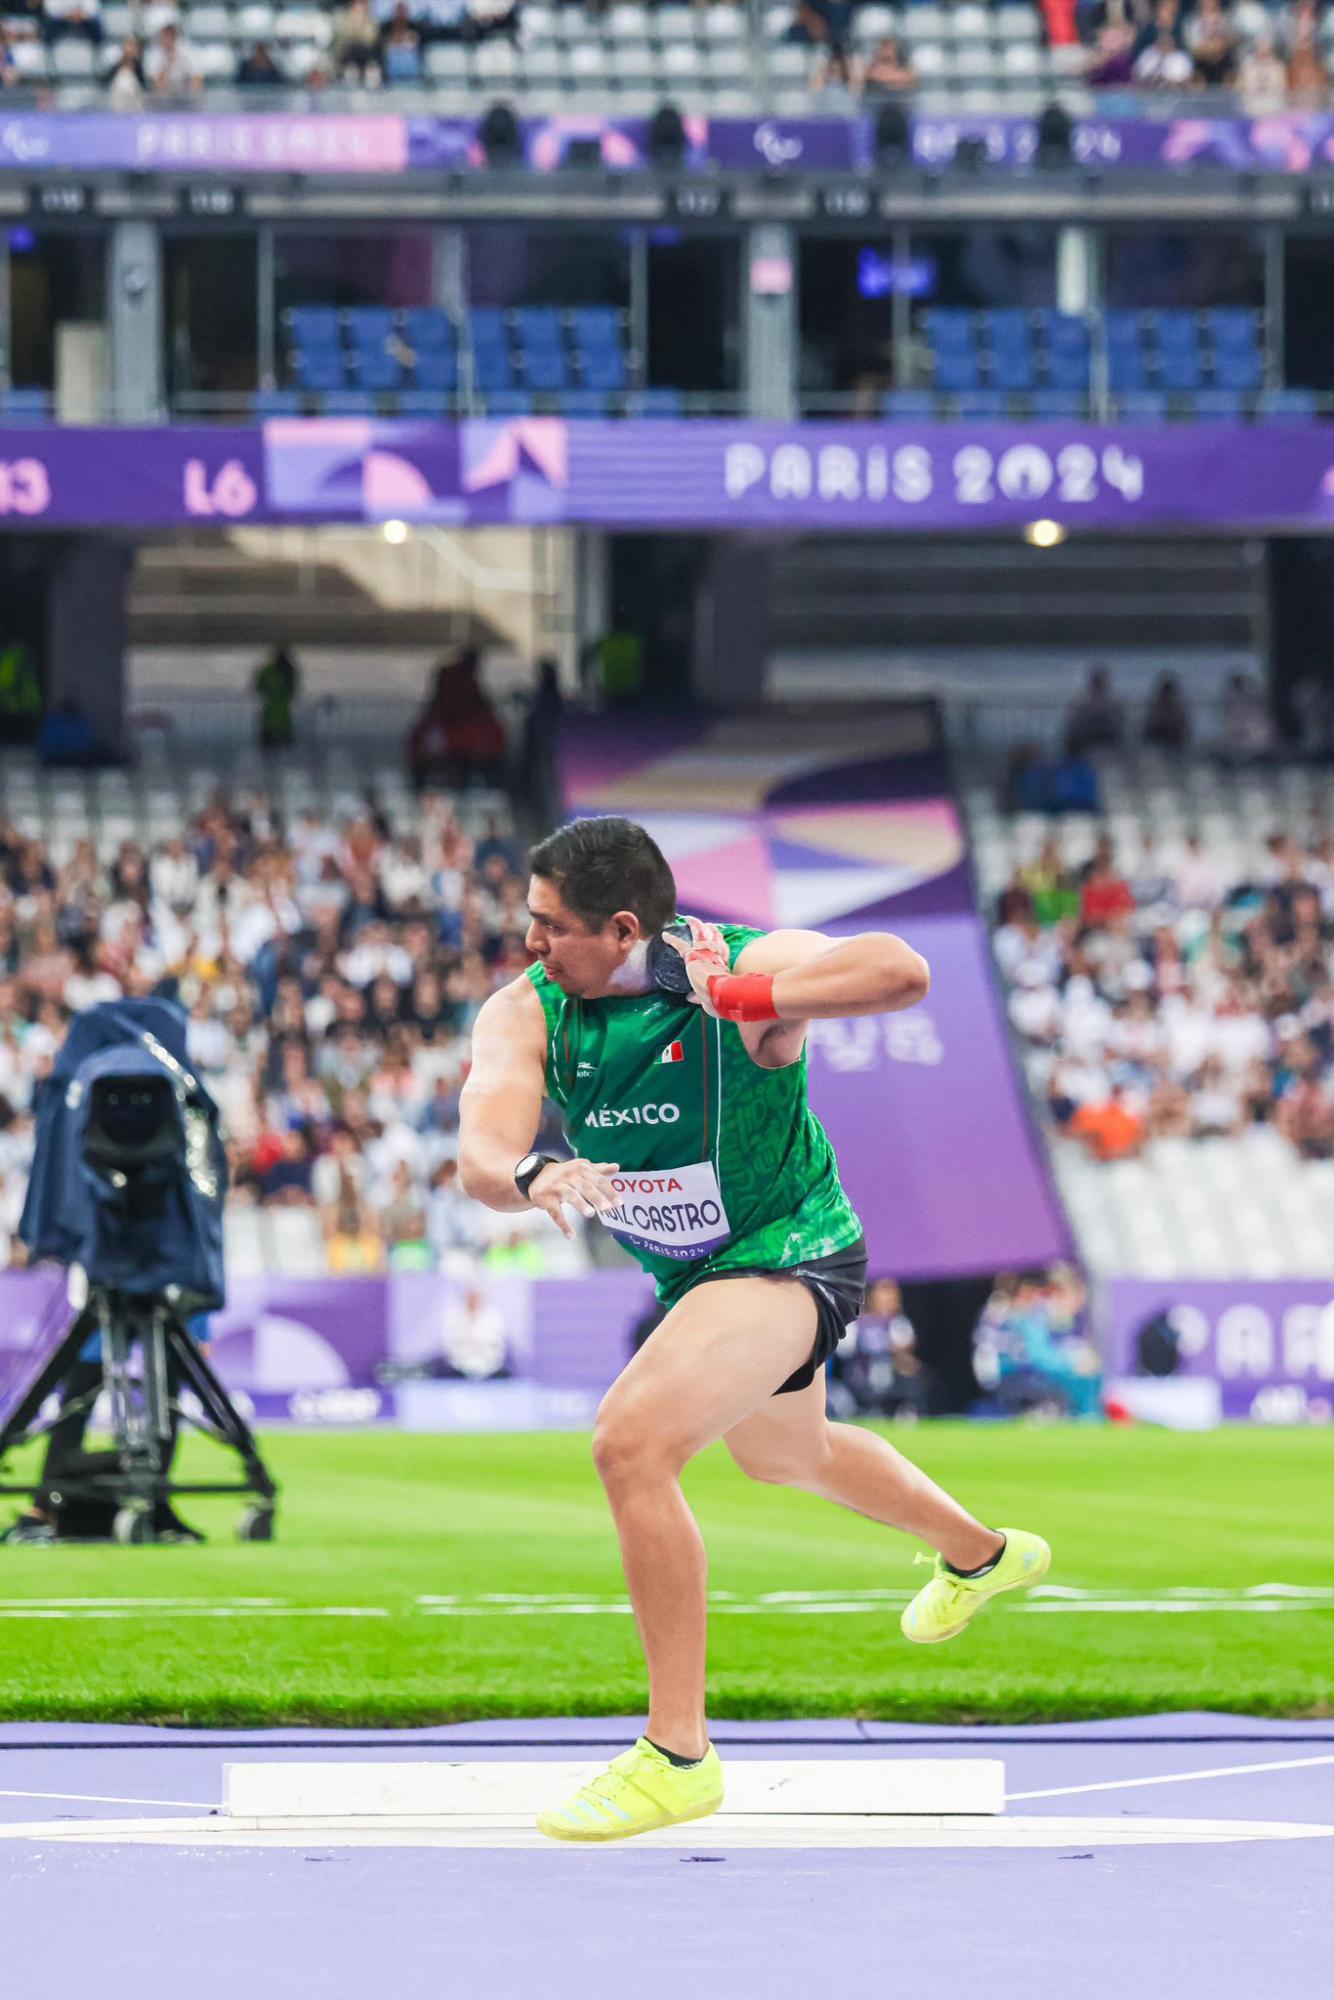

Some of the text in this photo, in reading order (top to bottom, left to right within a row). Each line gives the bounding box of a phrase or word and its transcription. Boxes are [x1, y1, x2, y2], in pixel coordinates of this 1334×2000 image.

[184, 458, 257, 515] L6
[725, 442, 1143, 503] PARIS 2024
[585, 1103, 680, 1128] MÉXICO
[611, 1178, 683, 1194] OYOTA
[632, 1199, 721, 1233] CASTRO
[643, 1240, 705, 1257] PARIS 2024
